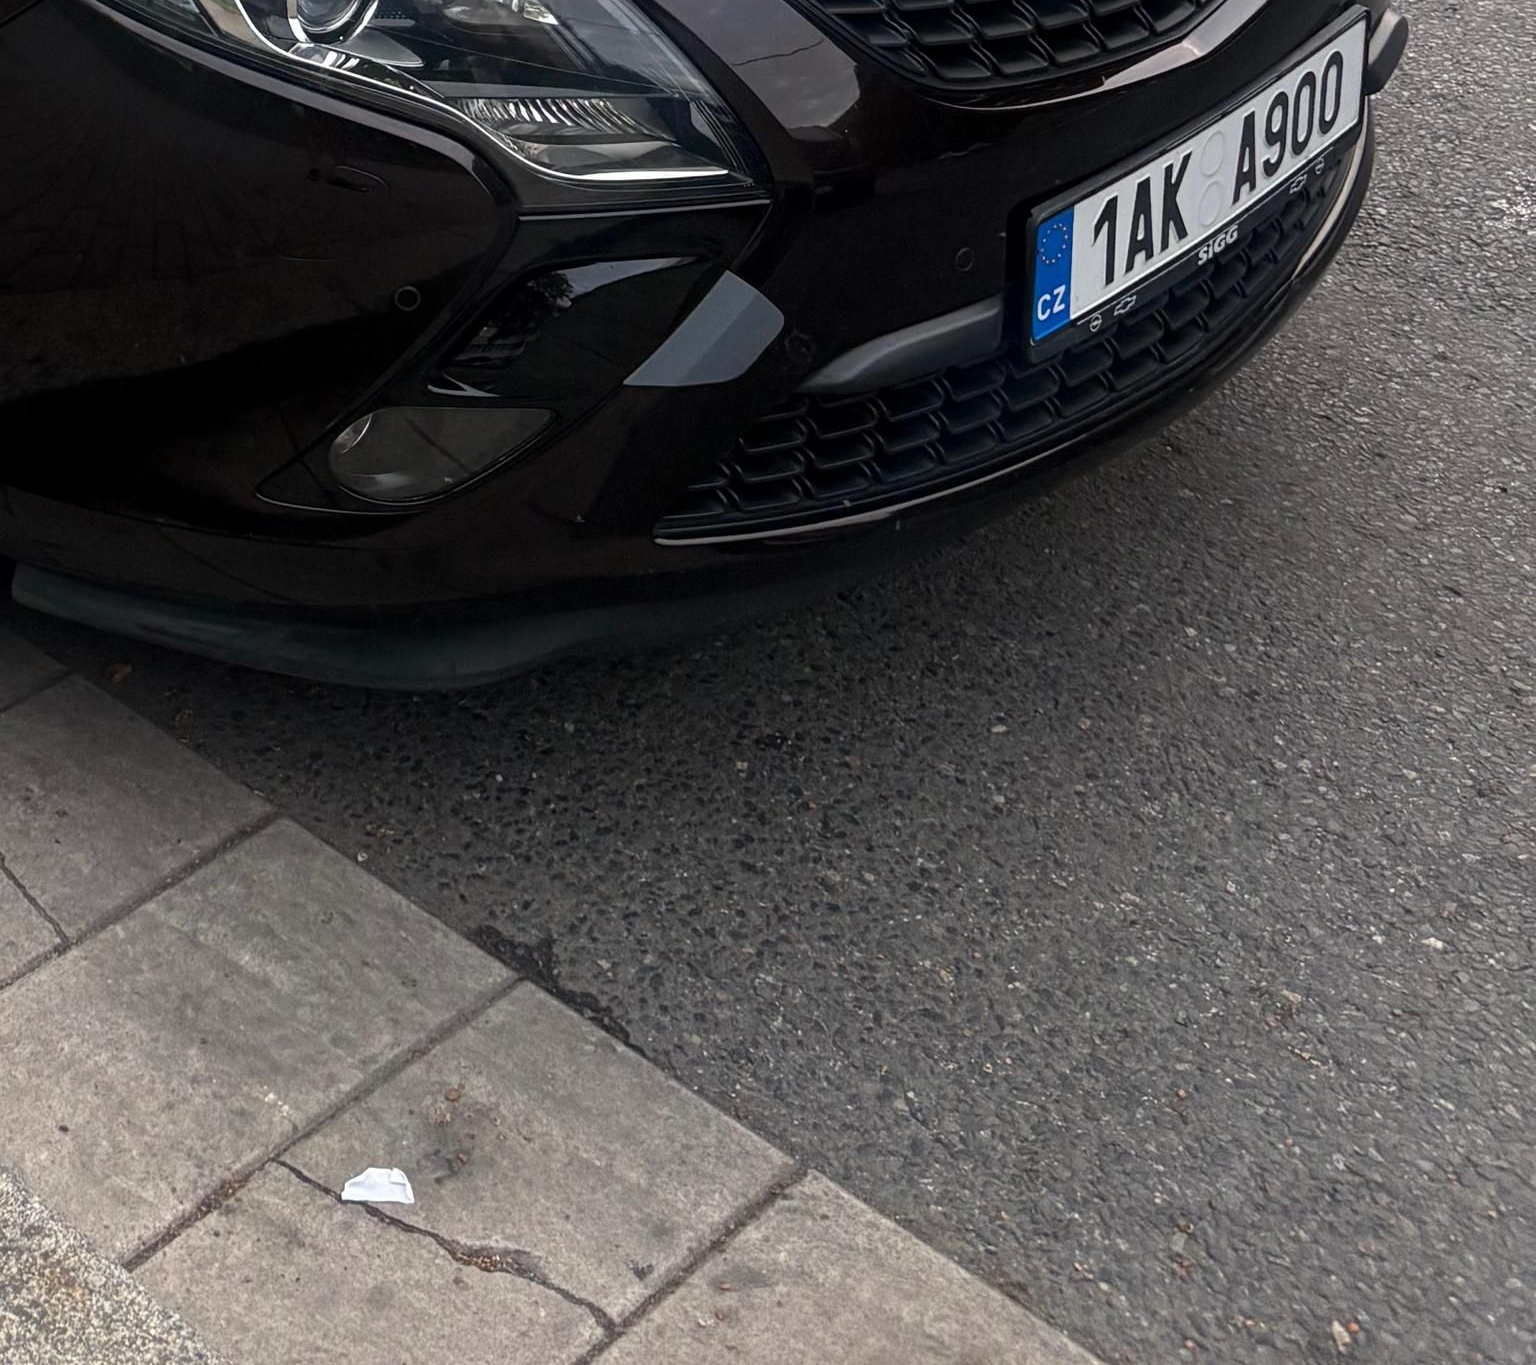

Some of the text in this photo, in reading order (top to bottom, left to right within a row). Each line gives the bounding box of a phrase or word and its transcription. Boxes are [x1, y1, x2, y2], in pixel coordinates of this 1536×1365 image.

[1093, 50, 1344, 286] 1AK A900
[1197, 224, 1239, 266] SIGG
[1037, 284, 1066, 321] CZ
